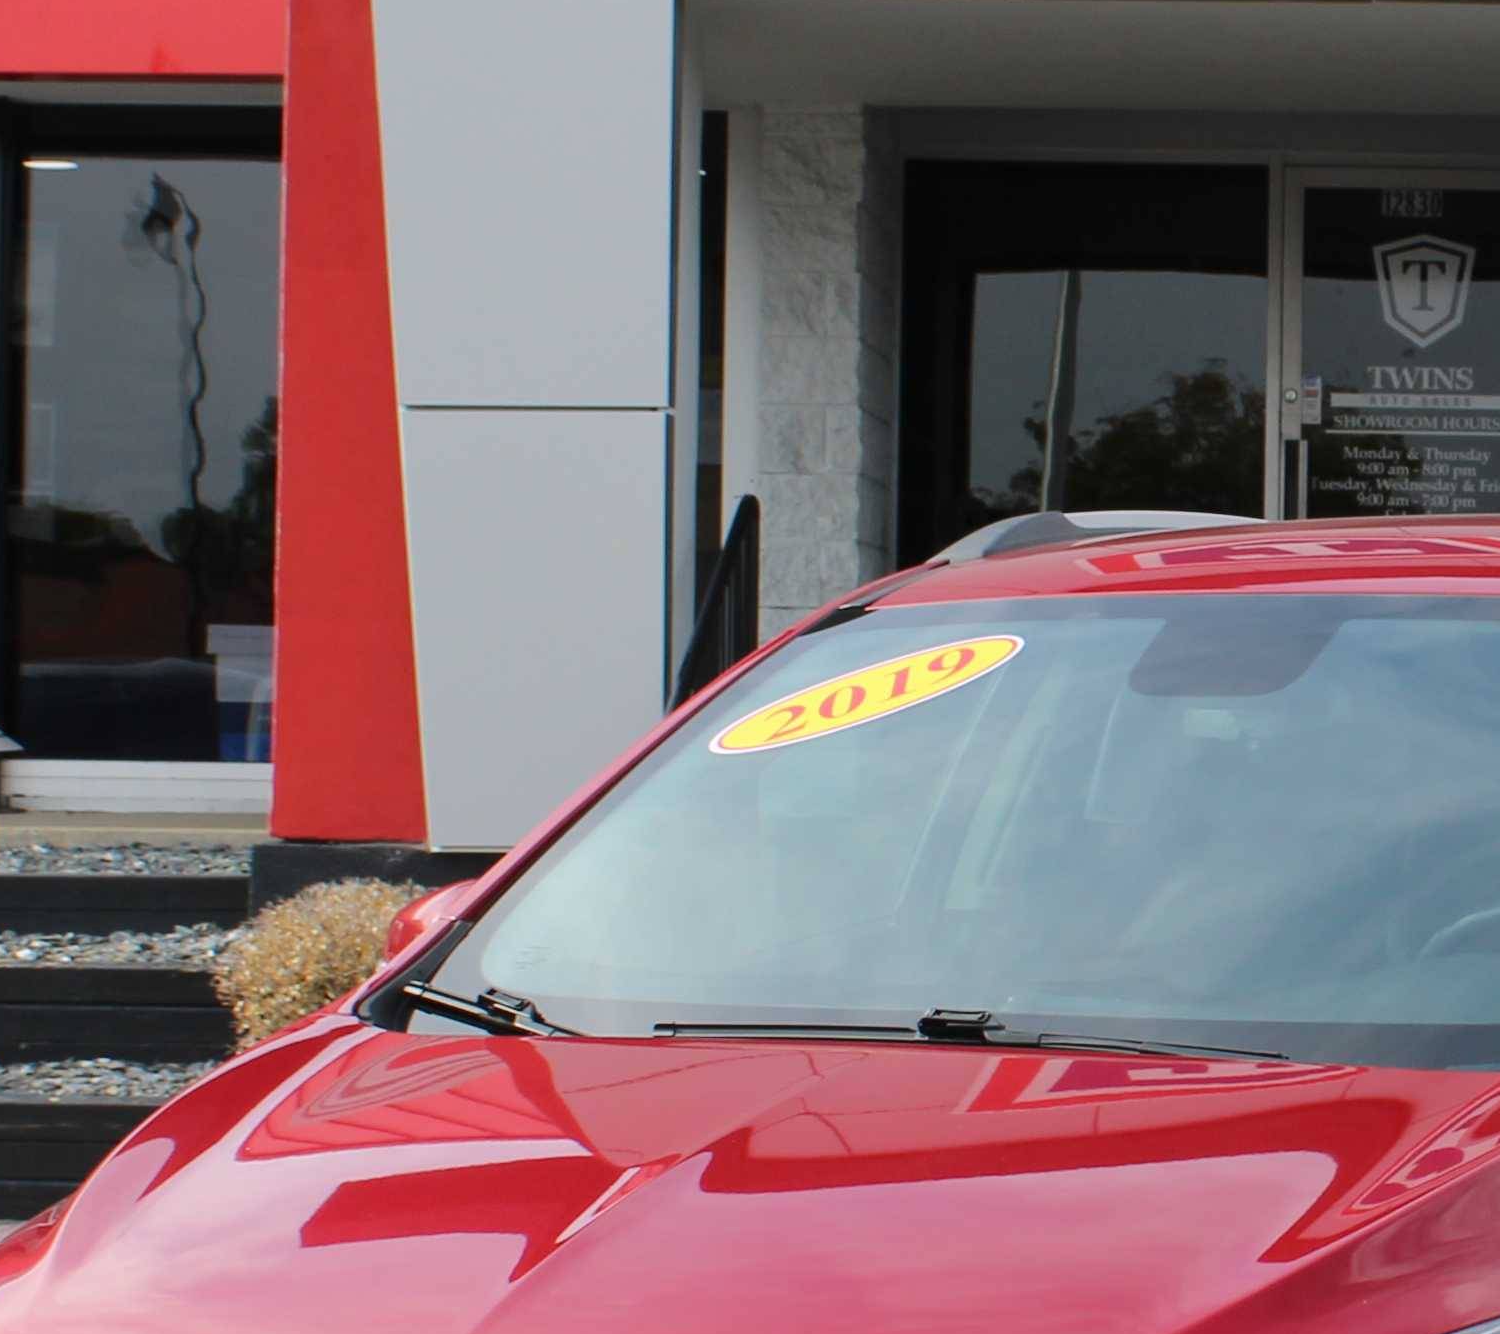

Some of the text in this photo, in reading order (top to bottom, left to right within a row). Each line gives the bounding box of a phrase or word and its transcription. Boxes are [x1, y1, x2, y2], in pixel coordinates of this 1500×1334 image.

[1401, 259, 1448, 312] T
[1367, 366, 1474, 391] TWINS
[1333, 415, 1438, 430] SHOWROOM
[1343, 446, 1492, 464] Monday & Thursday
[1356, 463, 1384, 474] 9:00
[1387, 466, 1409, 475] am
[1421, 463, 1450, 475] 8:00
[1452, 466, 1477, 479] pm
[1311, 477, 1373, 493] Tuesday,
[1375, 478, 1457, 494] Wednesday
[1462, 480, 1476, 492] &
[1356, 494, 1384, 506] 9:00
[1387, 496, 1409, 506] am
[1421, 494, 1450, 506] 7:00
[1452, 496, 1477, 510] pm
[763, 647, 976, 743] 2019
